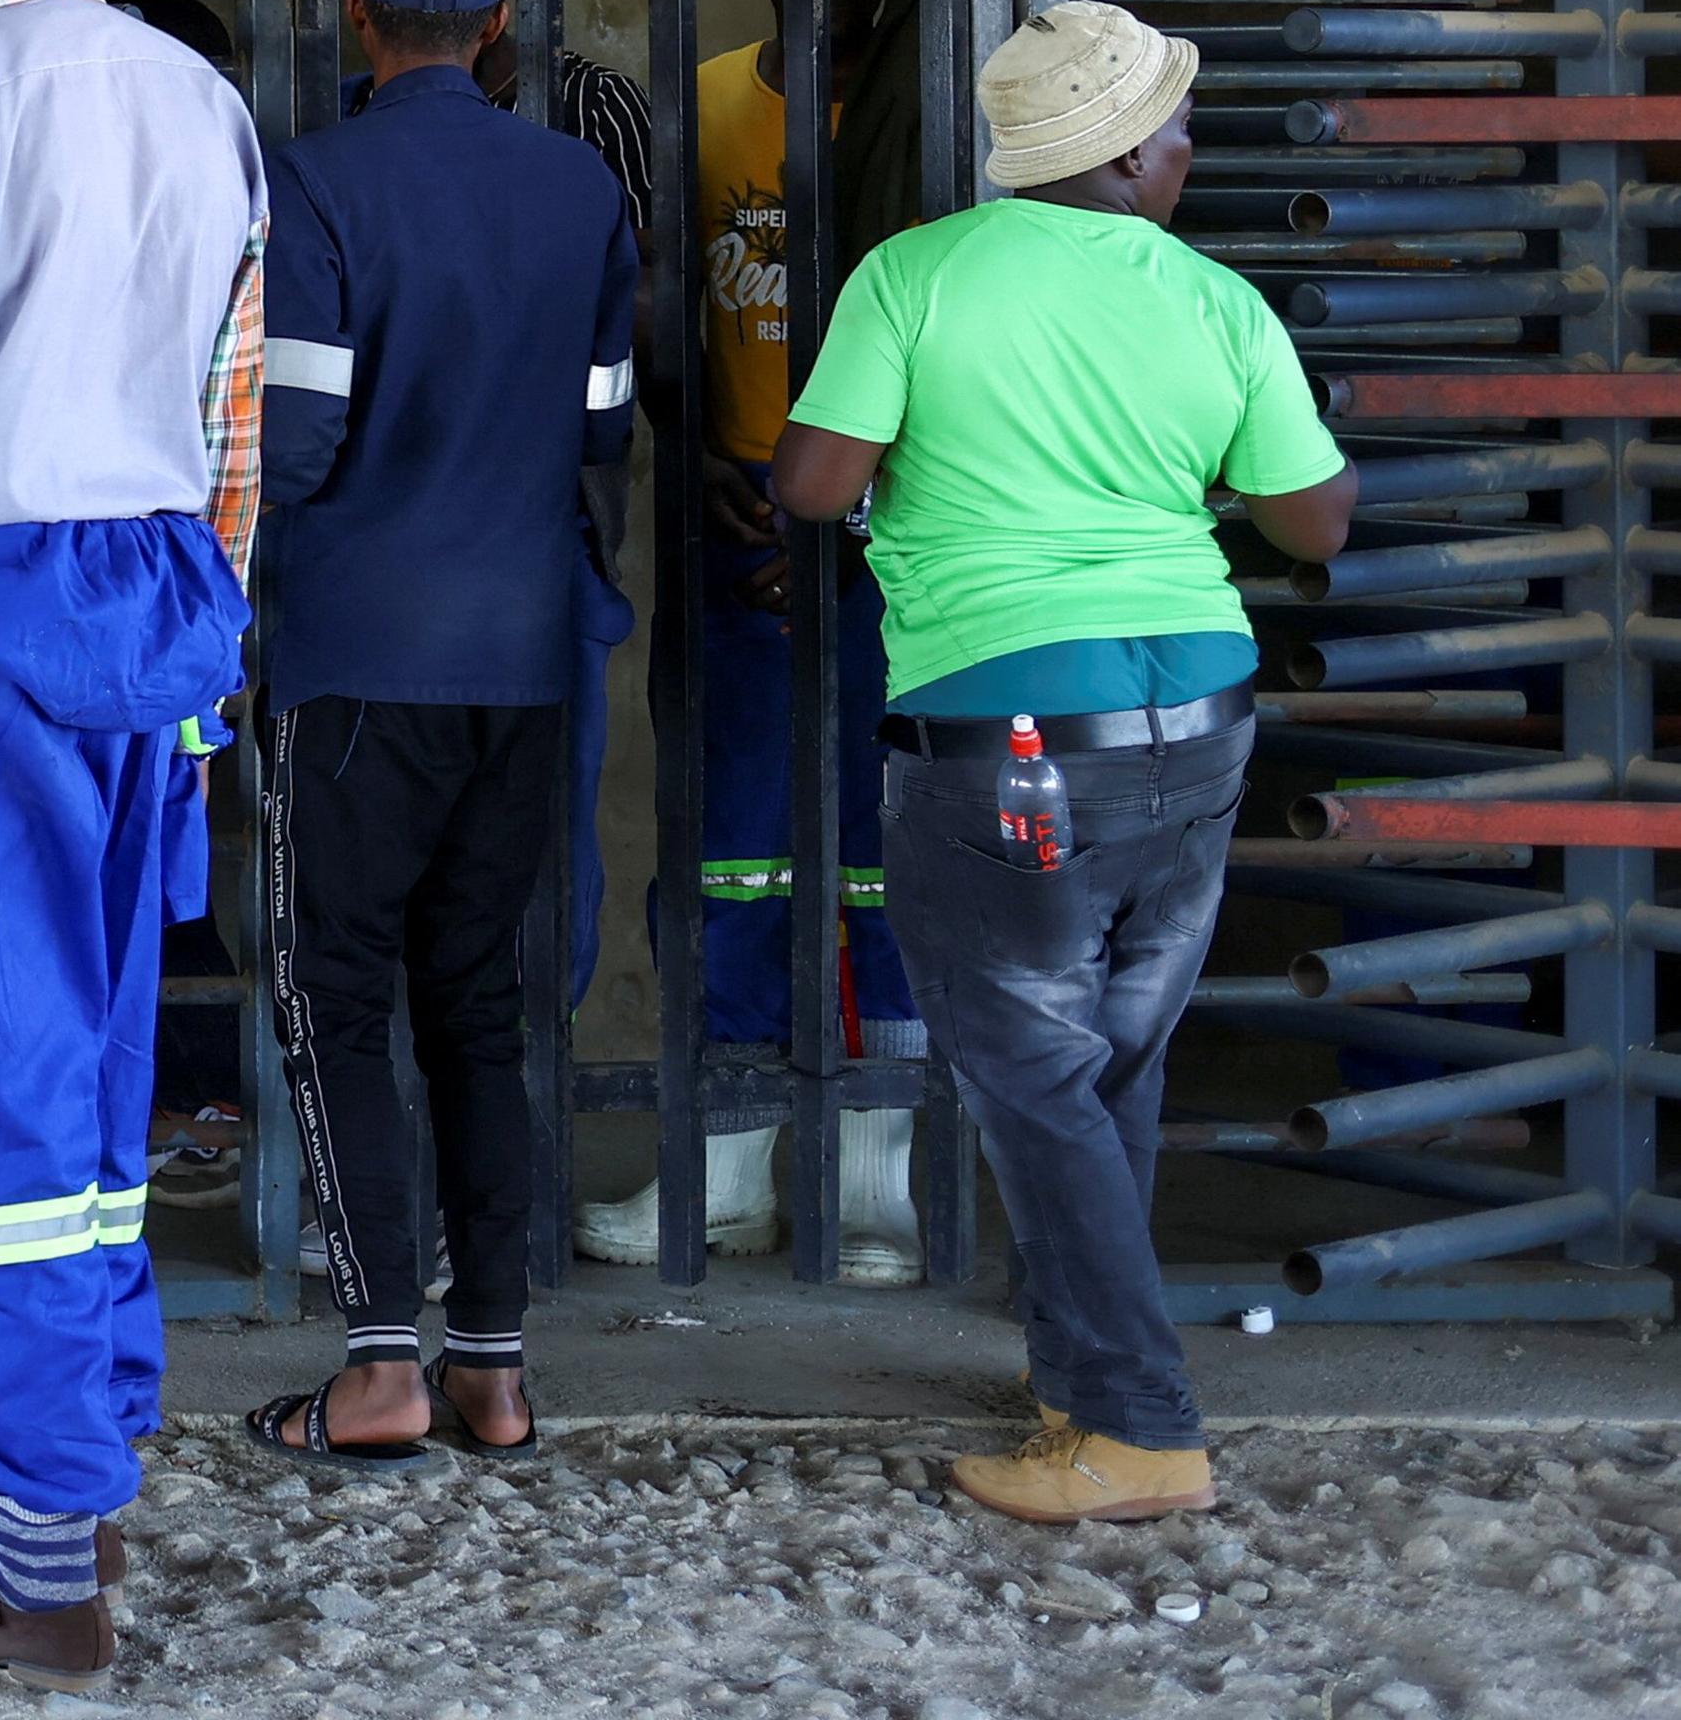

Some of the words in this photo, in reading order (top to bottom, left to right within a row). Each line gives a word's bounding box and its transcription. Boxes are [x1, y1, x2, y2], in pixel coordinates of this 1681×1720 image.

[273, 794, 285, 845] LOUIS
[273, 846, 285, 920] VUITTON
[277, 949, 290, 1000] LOUIS
[299, 1081, 316, 1130] LOUIS
[311, 1130, 332, 1204] VUITTON
[328, 1231, 352, 1279] LOUIS
